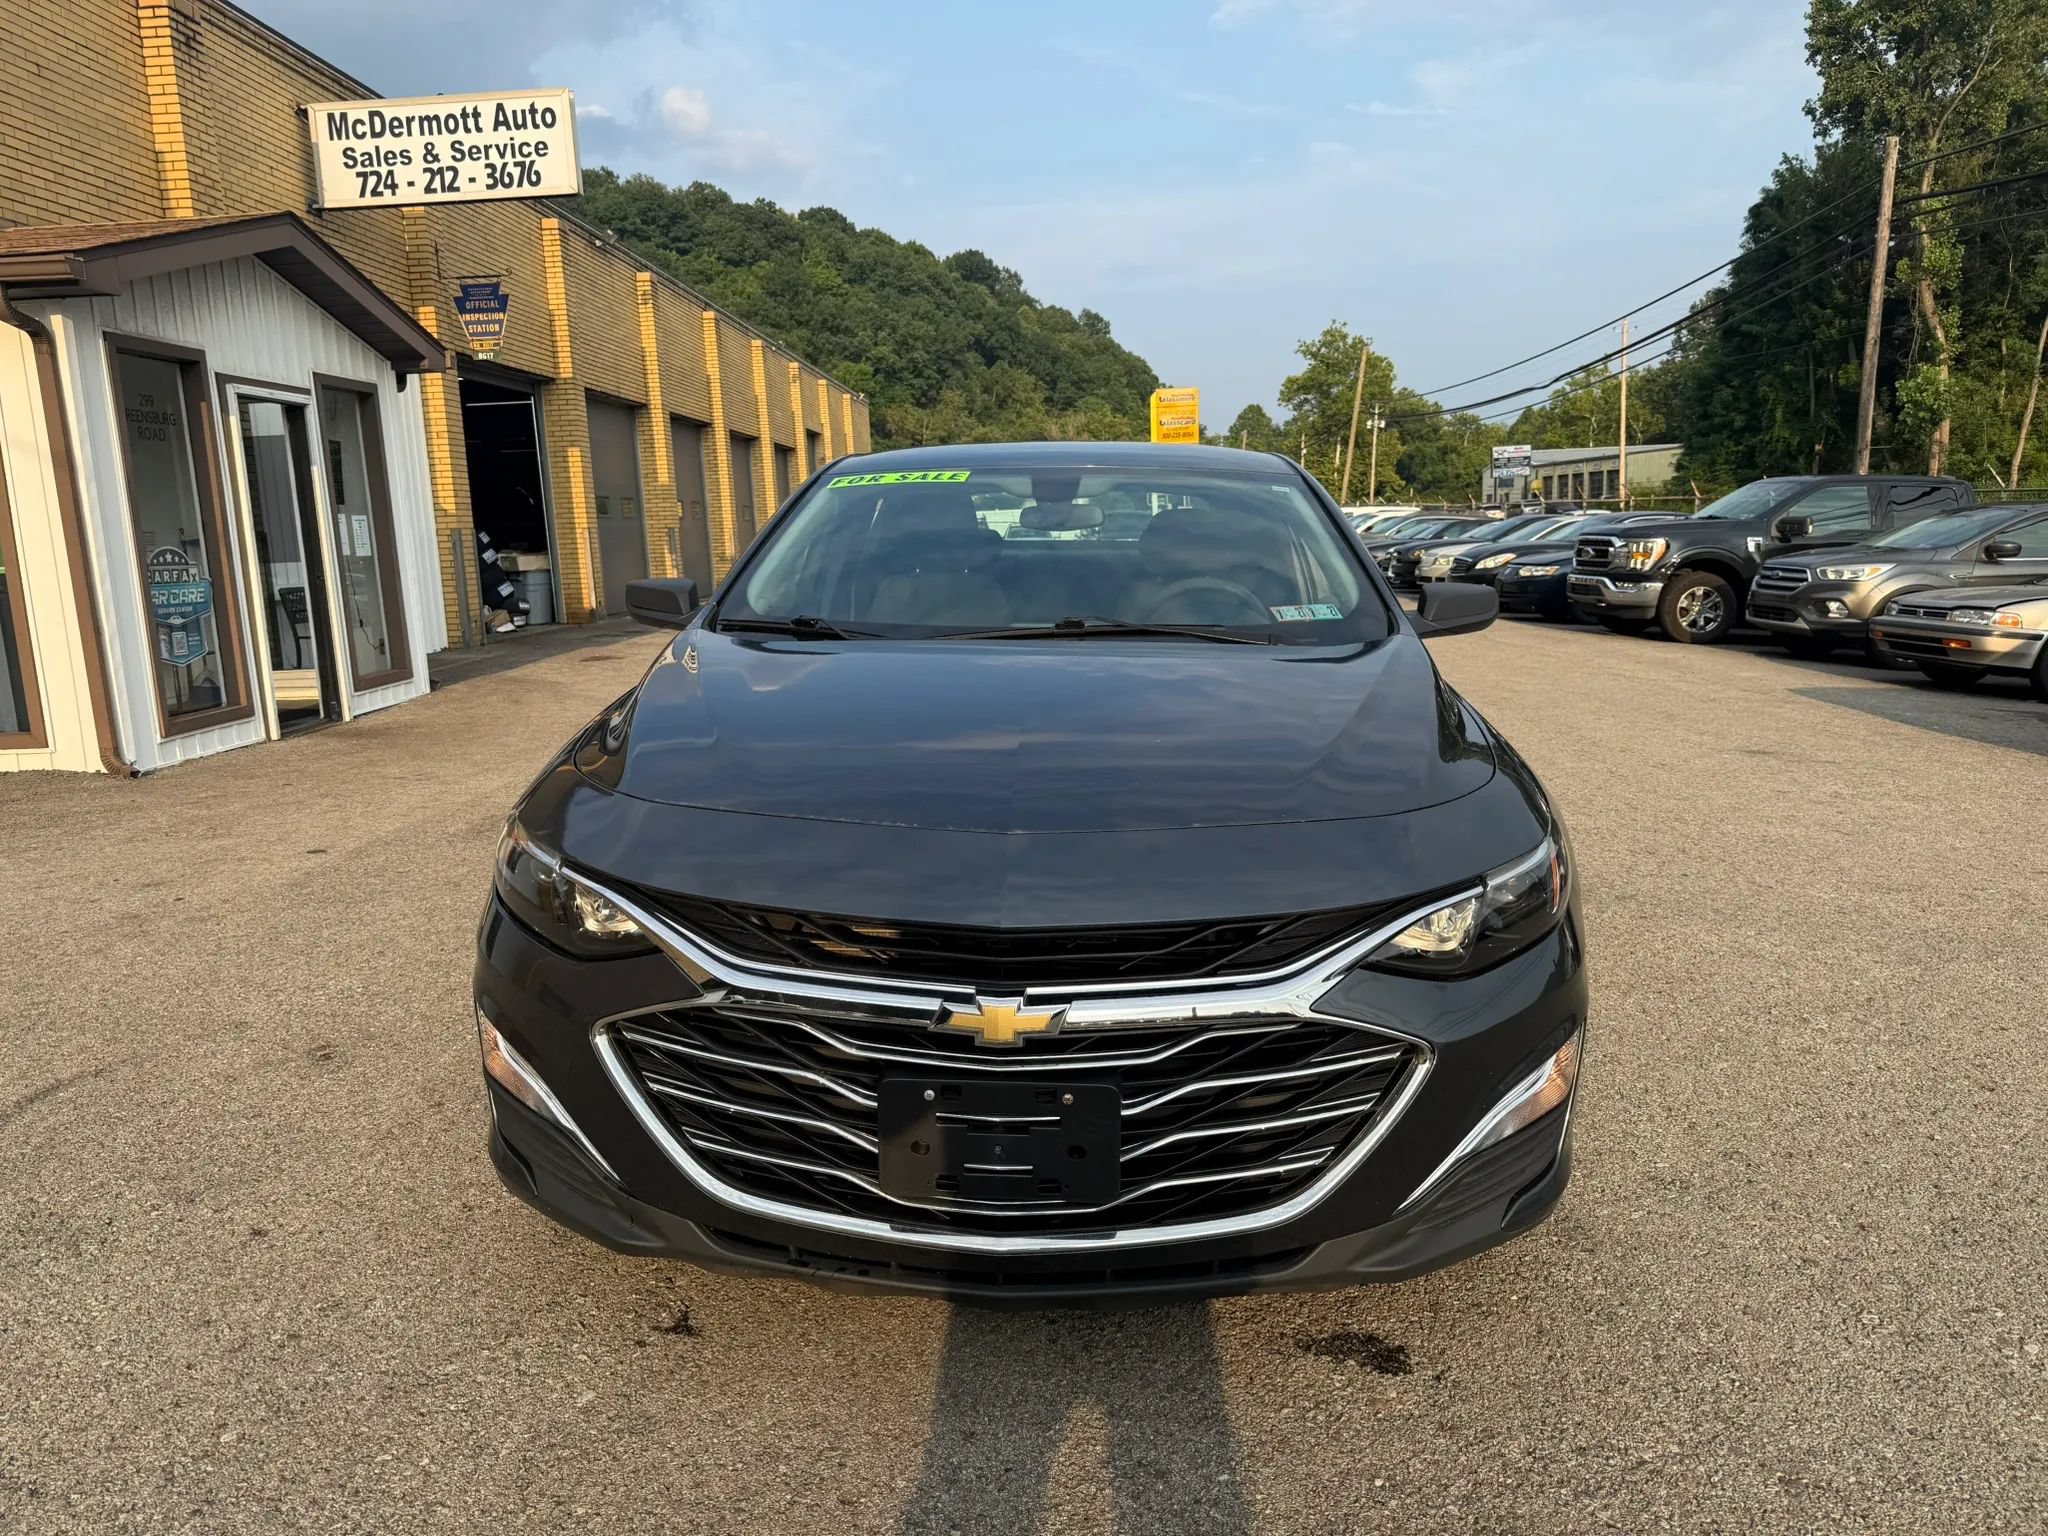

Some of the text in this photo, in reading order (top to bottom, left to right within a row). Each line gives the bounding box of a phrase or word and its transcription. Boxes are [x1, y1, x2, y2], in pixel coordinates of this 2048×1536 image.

[327, 101, 557, 141] McDermott Auto
[342, 137, 549, 169] Sales & Service
[355, 170, 399, 198] 724
[422, 165, 461, 195] 212
[485, 160, 541, 190] 3676
[466, 300, 500, 309] OFFICIAL
[462, 312, 504, 321] INSPECTION
[468, 324, 500, 333] STATION
[125, 408, 177, 426] REENSBURG
[137, 425, 166, 441] ROAD
[831, 472, 966, 486] FOR SALE
[151, 588, 205, 605] AR CARE
